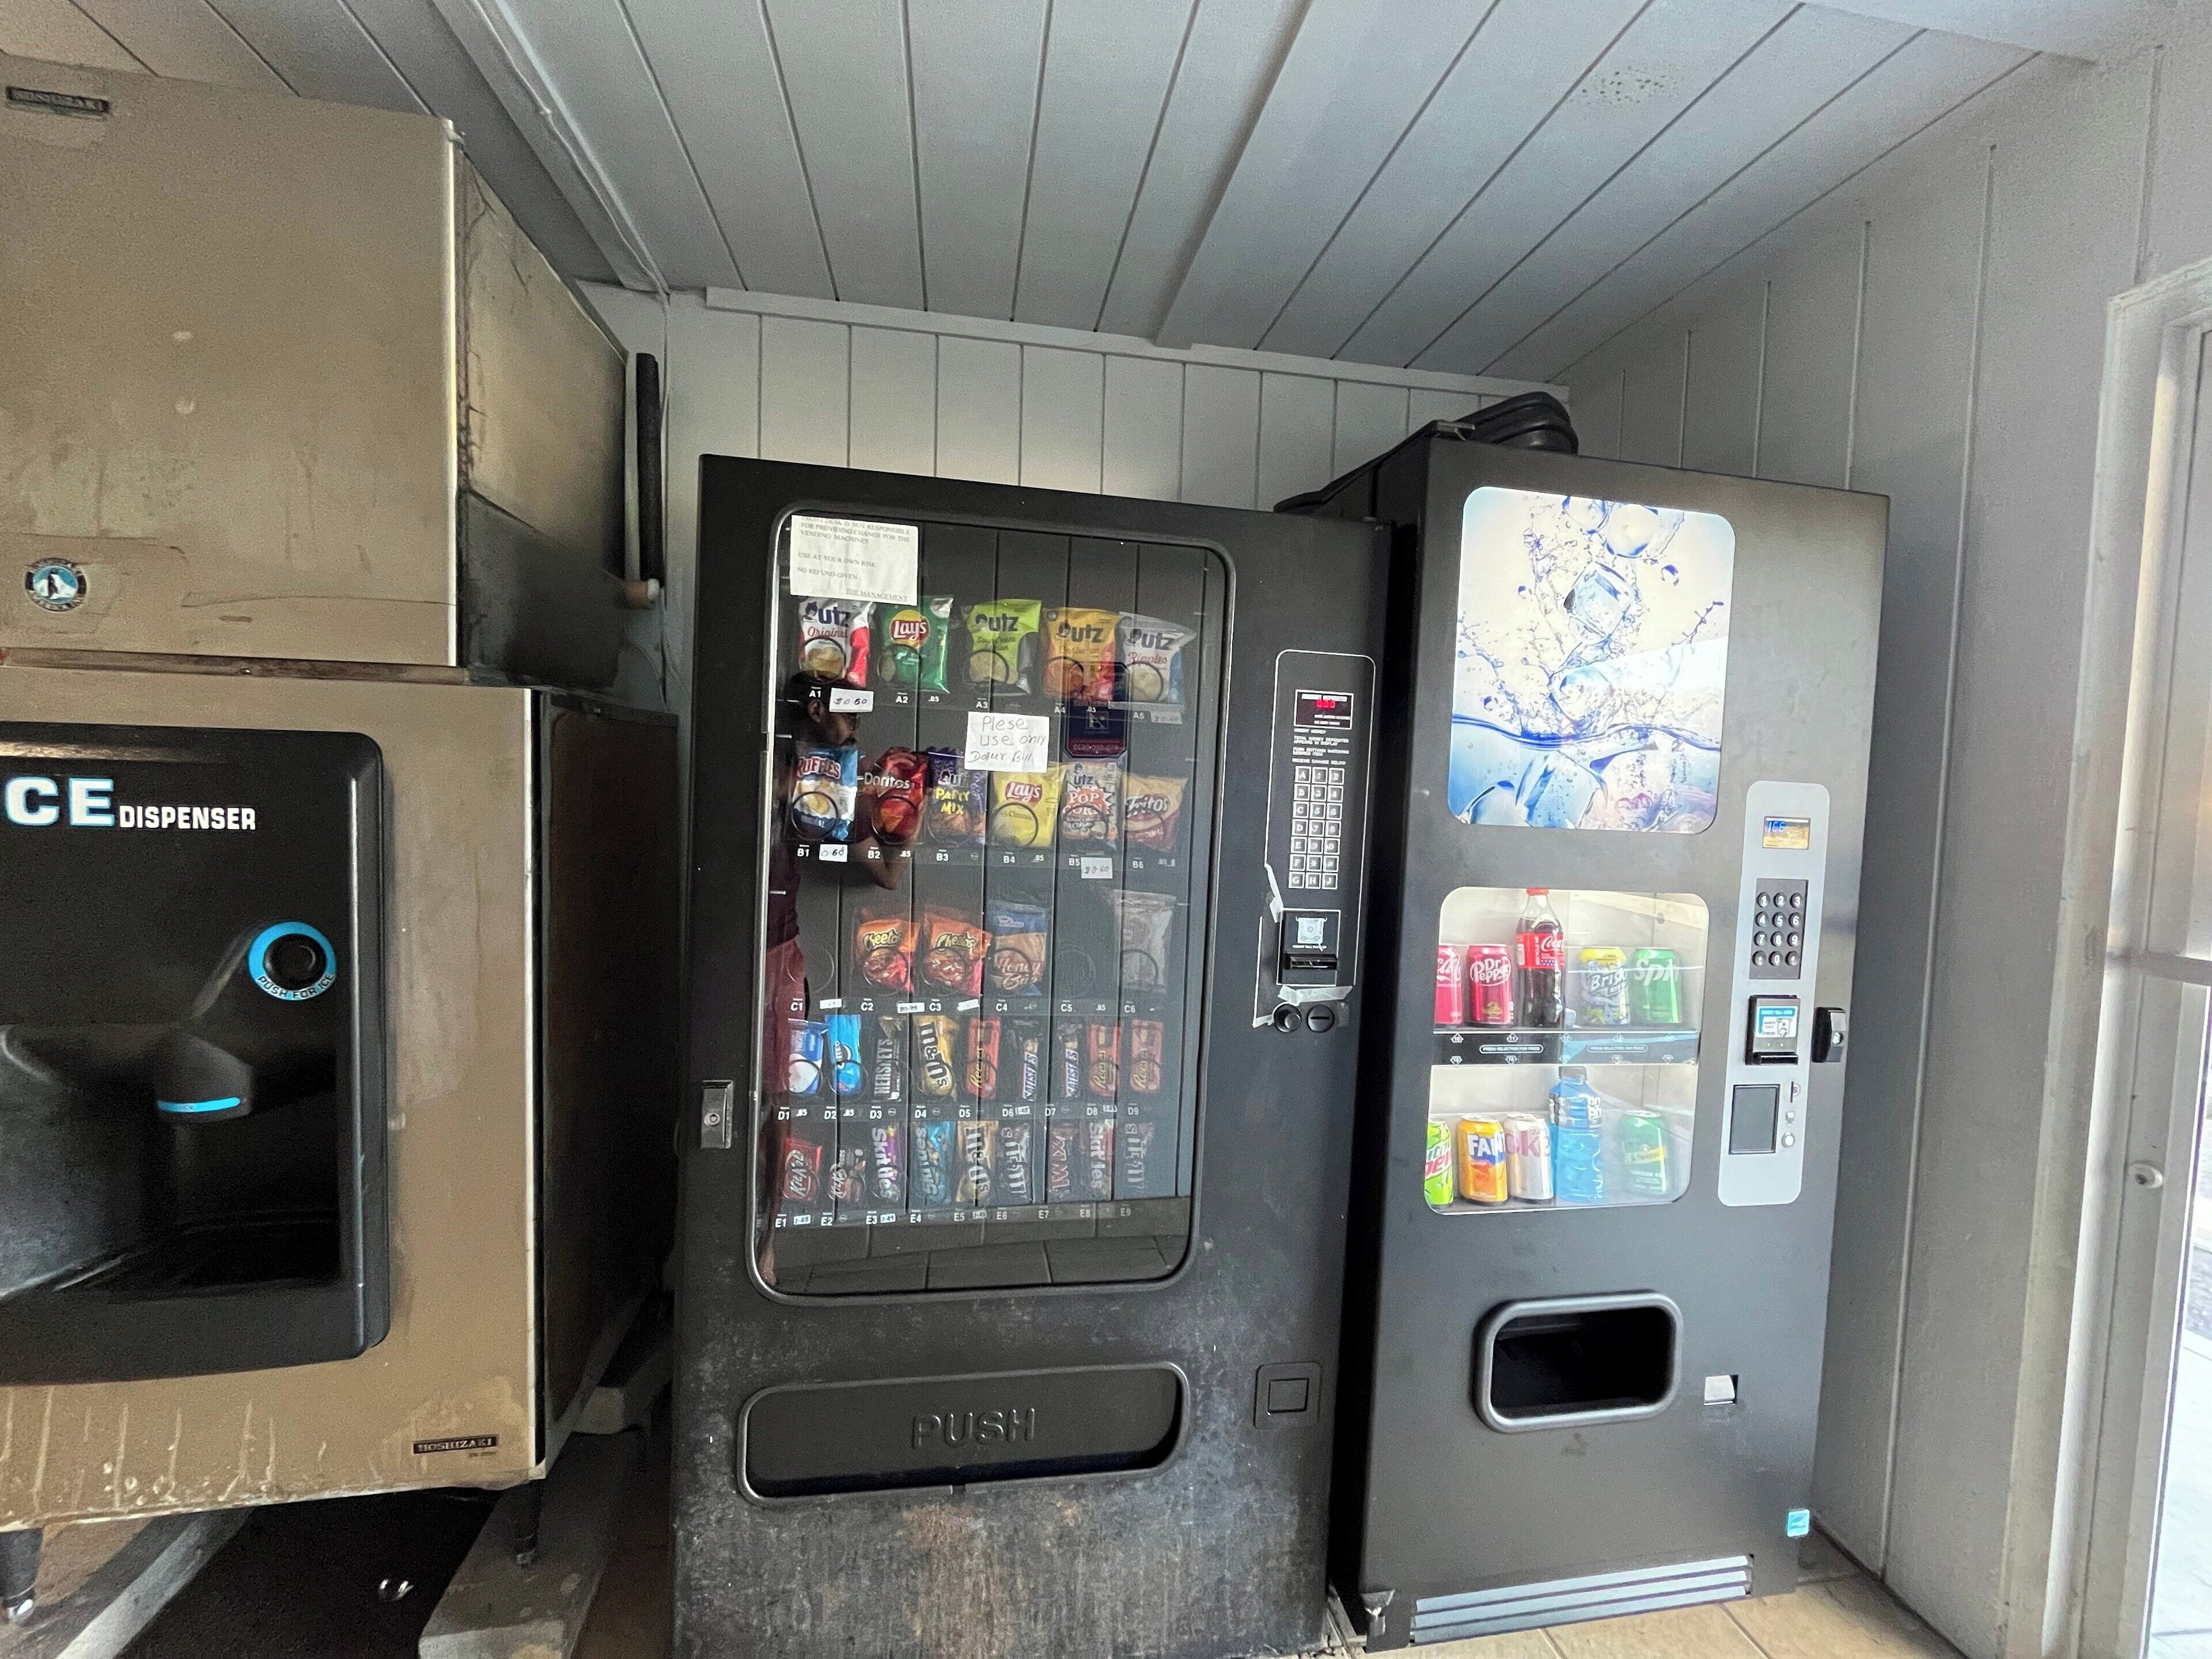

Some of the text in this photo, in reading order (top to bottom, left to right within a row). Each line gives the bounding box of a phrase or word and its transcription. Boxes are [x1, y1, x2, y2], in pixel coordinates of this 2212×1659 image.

[867, 524, 910, 535] RESPONSIBLE
[800, 529, 869, 544] VENDING MACHINES
[823, 555, 842, 563] YOUR
[844, 558, 860, 566] OWN
[861, 560, 877, 568] RISK
[808, 568, 836, 578] REFUND
[836, 571, 858, 580] GIVEN
[846, 588, 908, 603] THE MANAGEMENT
[809, 690, 821, 698] A1
[895, 695, 908, 704] A2
[976, 700, 988, 709] A3
[865, 771, 911, 790] Doritos
[1074, 774, 1094, 785] utz
[935, 787, 970, 801] PARTY
[1298, 788, 1305, 796] B
[1069, 791, 1100, 804] POP
[4, 775, 256, 831] CE DISPENSER
[941, 801, 964, 815] MIX
[1295, 841, 1302, 849] E
[797, 848, 810, 857] B1
[868, 850, 881, 859] B2
[936, 853, 949, 862] B3
[1003, 855, 1016, 864] B4
[1069, 857, 1081, 866] B5
[1294, 858, 1301, 866] F
[1132, 860, 1144, 869] B6
[1326, 877, 1332, 885] J
[1762, 895, 1767, 907] 1
[1778, 895, 1784, 906] 2
[1794, 896, 1801, 906] 3
[1759, 914, 1766, 925] 4
[1777, 915, 1783, 926] 5
[1793, 915, 1799, 926] 6
[1759, 934, 1765, 945] 7
[1775, 934, 1781, 945] 8
[1791, 934, 1798, 945] 9
[1774, 954, 1780, 964] 0
[1484, 958, 1501, 972] Dr
[257, 973, 334, 998] PUSH FOR ICE
[790, 1002, 803, 1011] C1
[861, 1002, 874, 1011] C2
[929, 1003, 942, 1012] C3
[995, 1003, 1007, 1012] C4
[1060, 1003, 1073, 1012] C5
[1124, 1005, 1136, 1013] C6
[778, 1111, 790, 1120] D1
[824, 1111, 836, 1119] D2
[869, 1110, 882, 1119] D3
[915, 1109, 927, 1118] D4
[959, 1109, 971, 1118] D5
[1002, 1108, 1014, 1117] D6
[1044, 1108, 1056, 1116] D7
[1086, 1107, 1099, 1116] D8
[1128, 1107, 1139, 1115] D9
[997, 1211, 1007, 1220] E6
[1039, 1210, 1050, 1219] E7
[1080, 1209, 1090, 1218] E8
[1120, 1207, 1131, 1217] E9
[820, 1217, 833, 1226] E2
[866, 1215, 877, 1225] E3
[910, 1214, 922, 1223] E4
[953, 1212, 965, 1222] E5
[775, 1218, 787, 1228] E1
[912, 1408, 1035, 1450] PUSH
[418, 1438, 493, 1452] HOSHIZAKI
